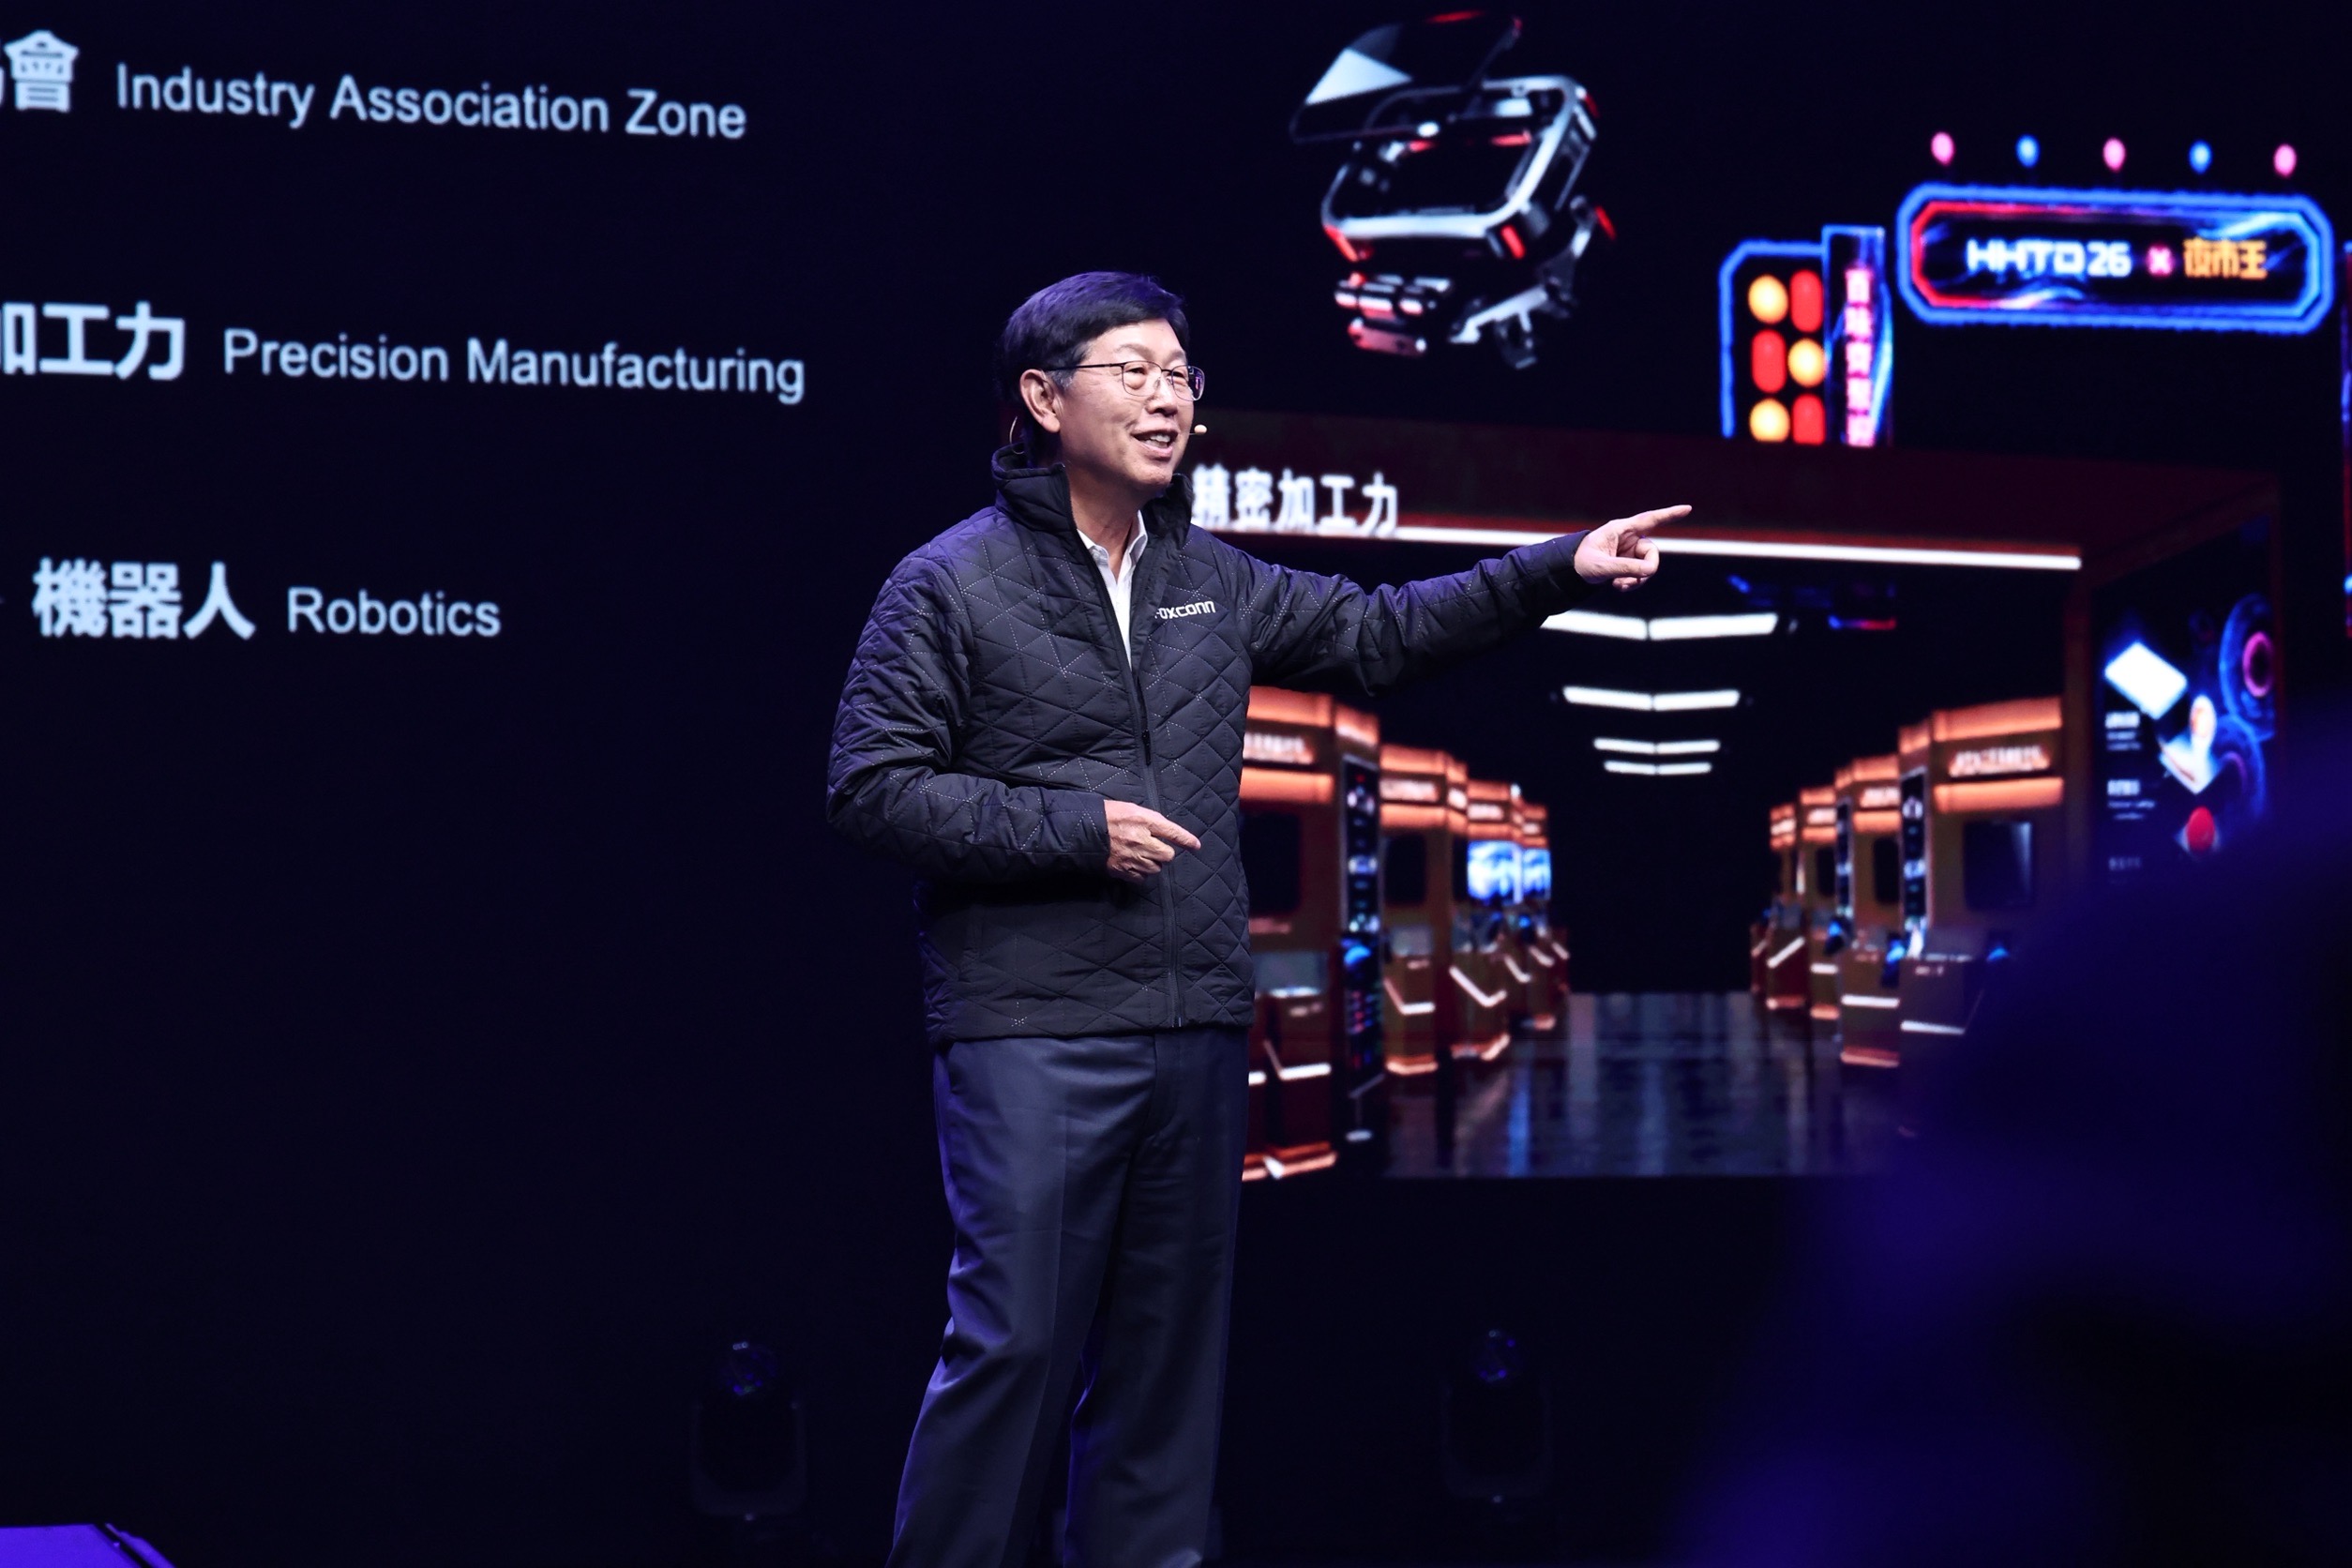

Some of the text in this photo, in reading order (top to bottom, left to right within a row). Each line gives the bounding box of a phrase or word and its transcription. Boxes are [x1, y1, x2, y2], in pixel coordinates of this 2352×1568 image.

[0, 29, 80, 113] 會
[117, 63, 746, 140] Industry Association Zone
[223, 327, 805, 405] Precision Manufacturing
[1191, 463, 1399, 536] 精密加工力
[31, 556, 256, 641] 機器人
[287, 586, 502, 638] Robotics
